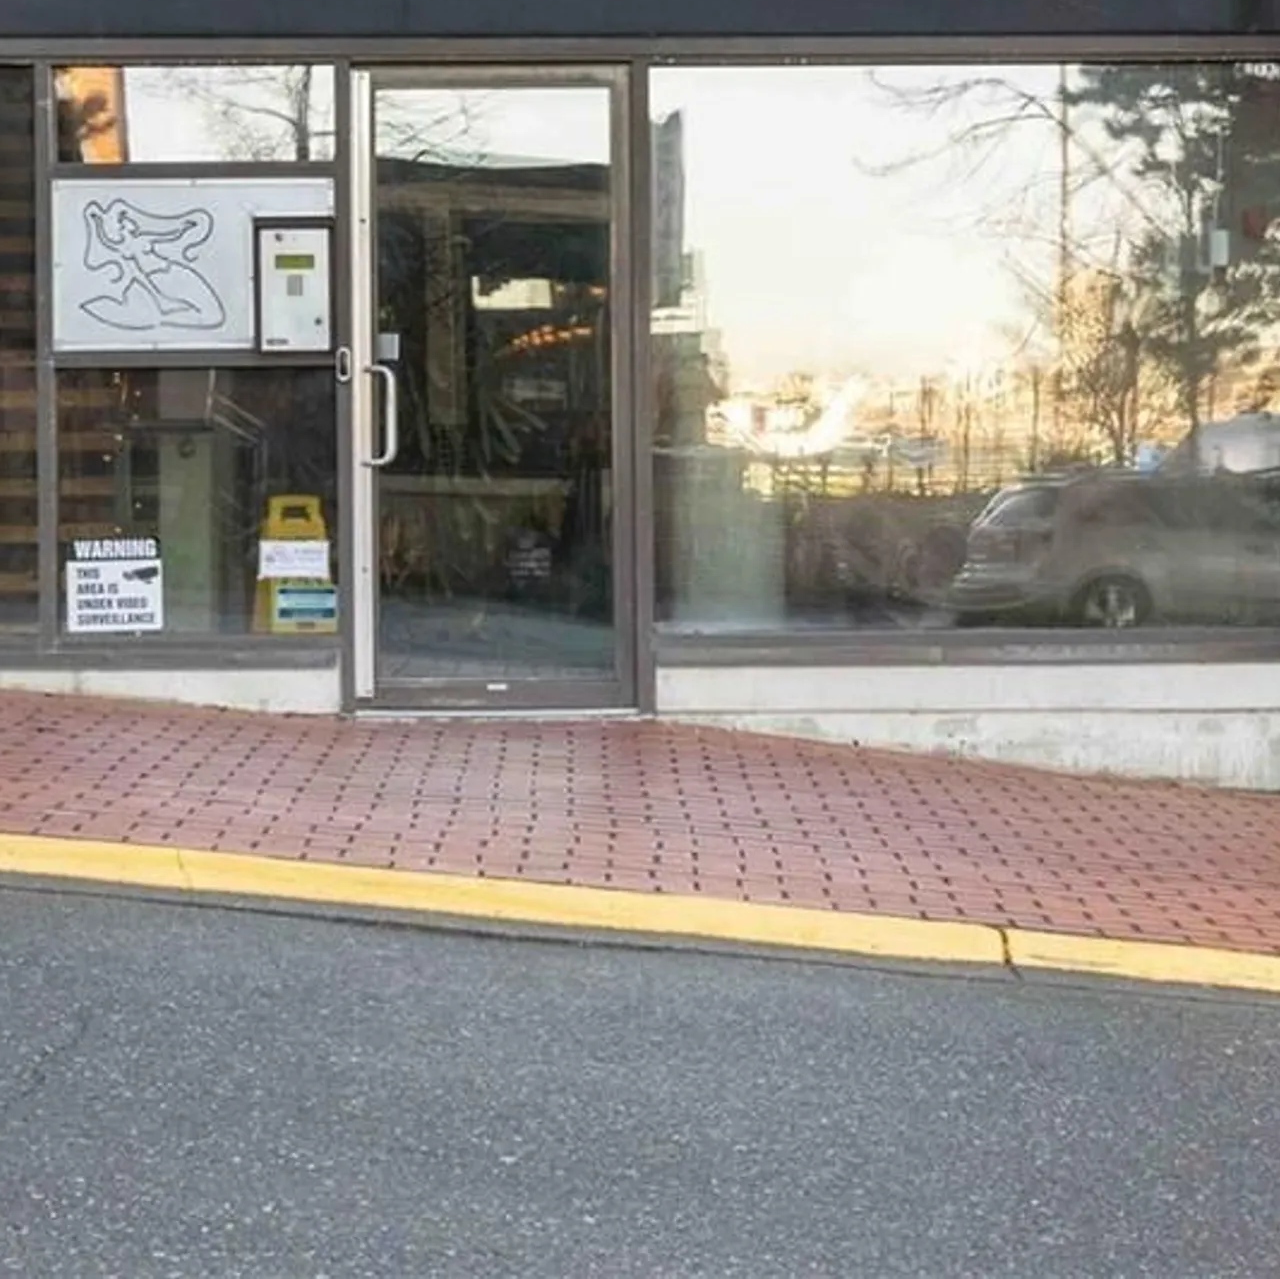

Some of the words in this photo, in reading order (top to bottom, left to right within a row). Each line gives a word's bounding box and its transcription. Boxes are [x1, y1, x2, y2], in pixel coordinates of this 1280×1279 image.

[74, 539, 156, 558] WARNING
[76, 568, 100, 579] THIS
[76, 583, 104, 595] AREA
[107, 583, 119, 594] IS
[76, 598, 113, 610] UNDER
[117, 597, 148, 609] VIDEO
[76, 613, 155, 625] SURVEILLANCE
